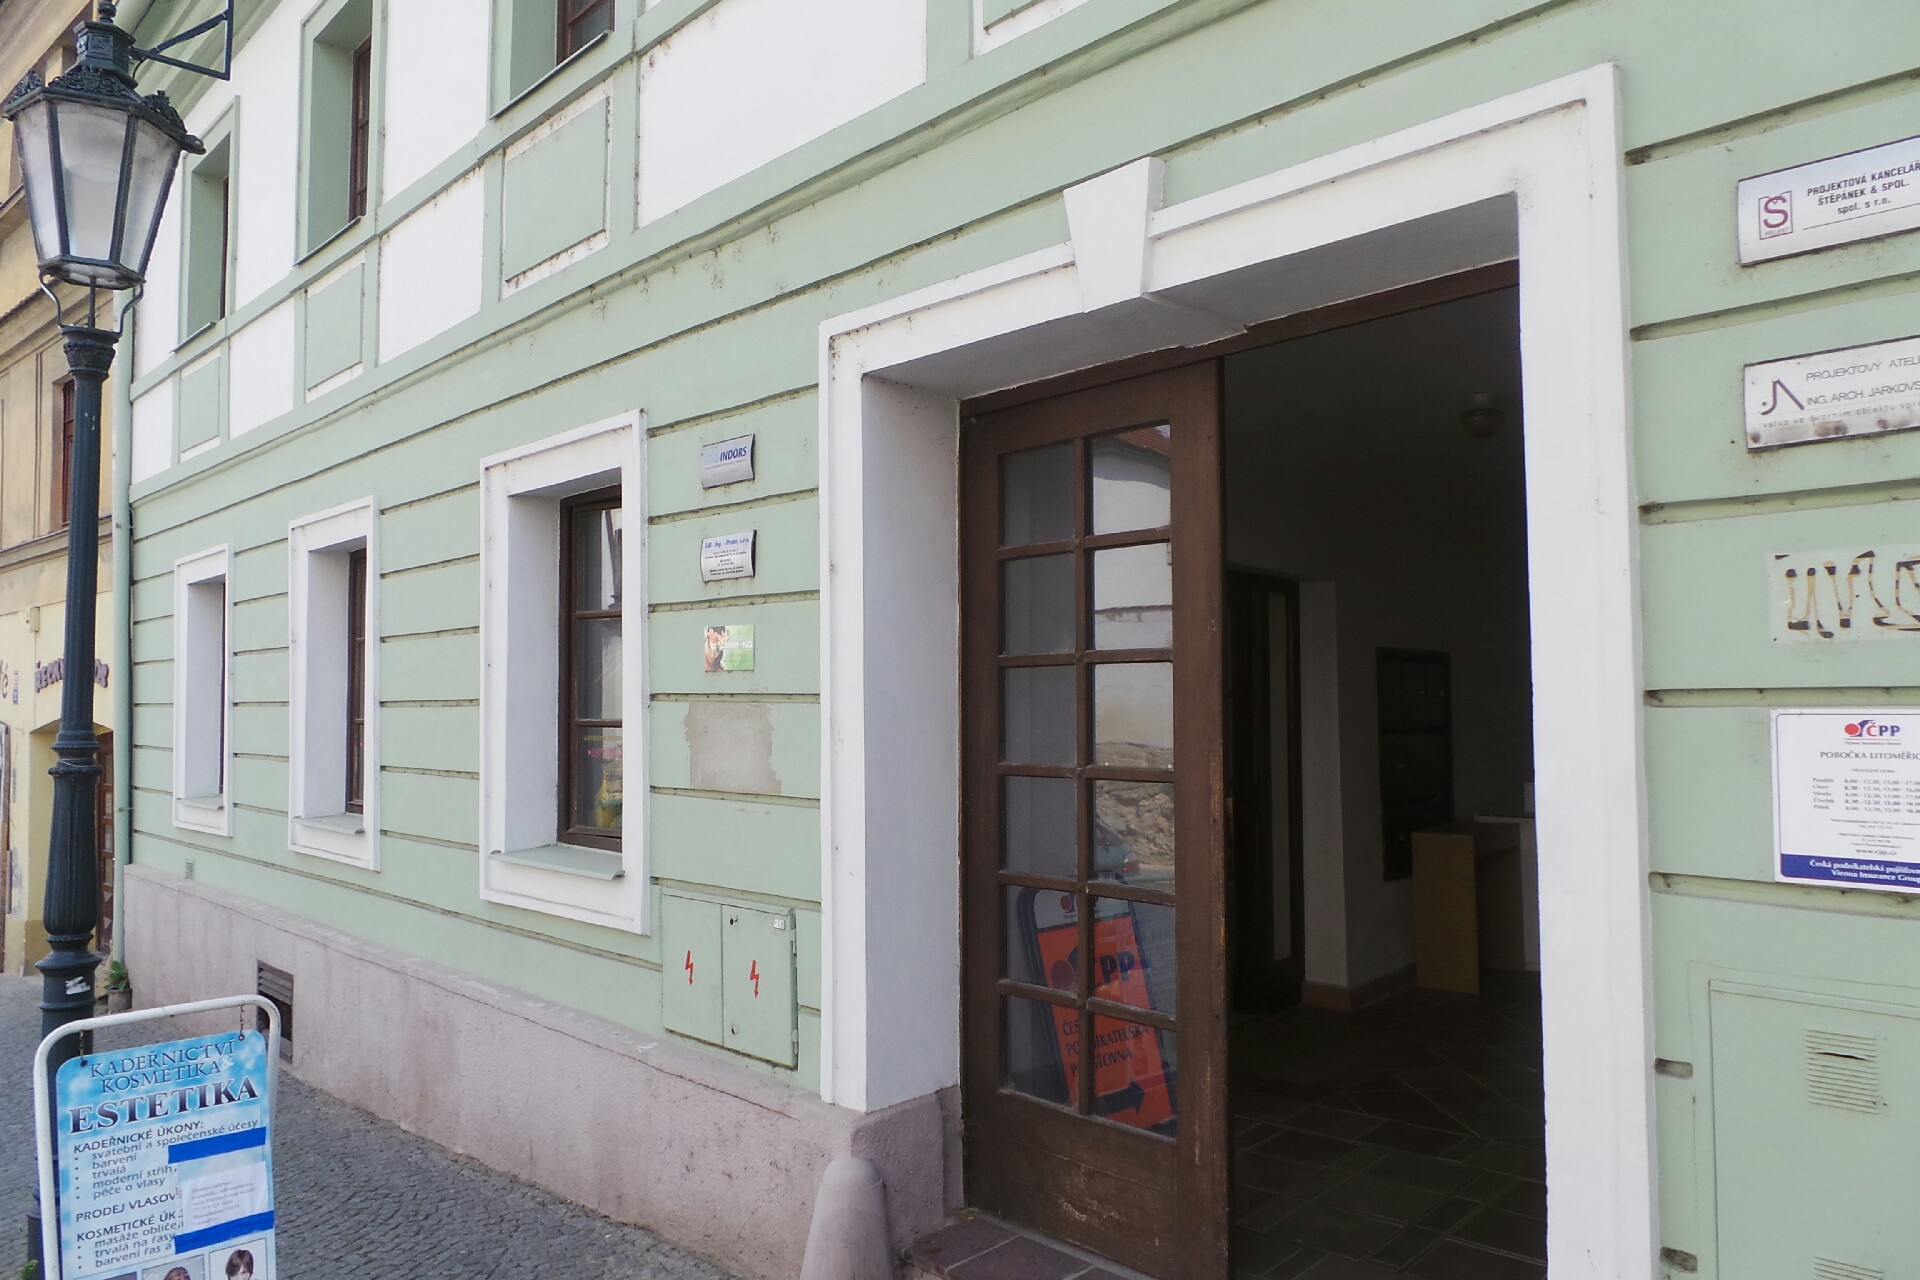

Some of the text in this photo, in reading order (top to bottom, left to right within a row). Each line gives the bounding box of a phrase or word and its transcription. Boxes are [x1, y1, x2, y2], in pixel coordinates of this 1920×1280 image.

[1807, 173, 1867, 196] PROJEKTOVÁ
[1818, 179, 1910, 206] ŠTĚPÁNEK & SPOL.
[1837, 197, 1891, 216] spol. s r.o.
[1806, 395, 1829, 406] ING.
[1831, 389, 1866, 403] ARCH.
[720, 446, 747, 461] INDORS
[1866, 722, 1900, 737] ČPP
[1820, 750, 1867, 759] POBOČKA
[1810, 859, 1832, 868] Česká
[1833, 861, 1885, 872] podnikatelská
[1831, 869, 1858, 878] Vienna
[1860, 871, 1896, 881] Insurance
[90, 1039, 235, 1079] KADEŘNICTVÍ
[101, 1060, 221, 1094] KOSMETIKA
[69, 1077, 259, 1134] ESTETIKA
[74, 1120, 204, 1154] KADEŘNICKÉ ÚKONY:
[92, 1119, 258, 1161] svatební a společenské účesy
[92, 1153, 137, 1170] barvení
[92, 1166, 127, 1179] trvalá
[93, 1171, 143, 1189] moderní
[93, 1177, 166, 1200] péče o vlasy
[76, 1203, 125, 1222] PRODEJ
[129, 1192, 176, 1211] VLASOV
[77, 1213, 155, 1242] KOSMETICKÉ
[94, 1231, 139, 1248] masáže
[95, 1244, 129, 1259] trvalá
[133, 1239, 148, 1249] na
[95, 1250, 140, 1268] barvení
